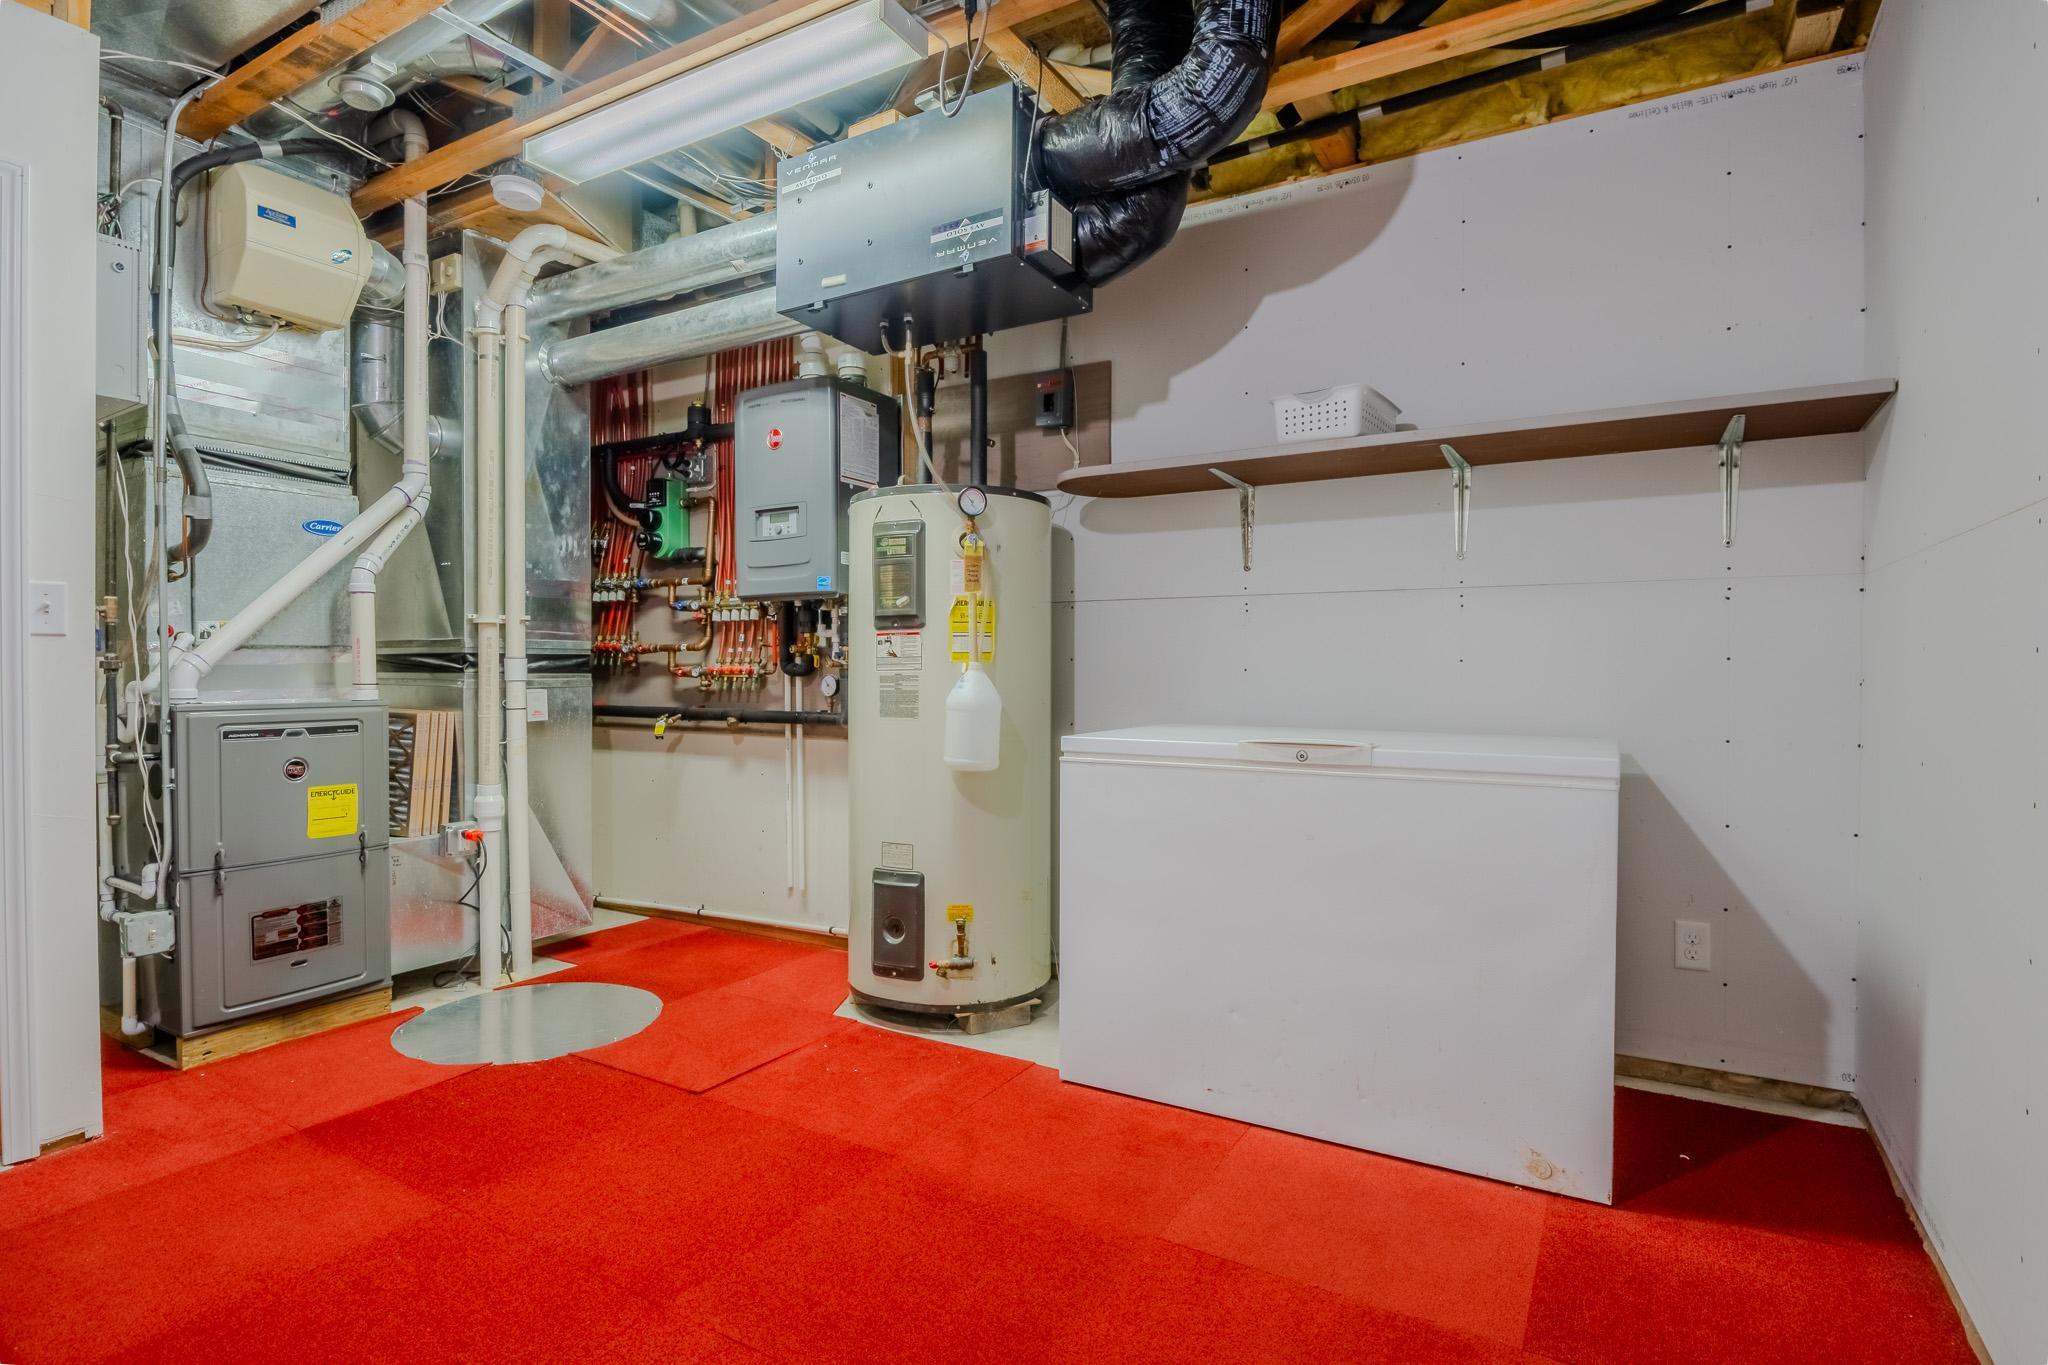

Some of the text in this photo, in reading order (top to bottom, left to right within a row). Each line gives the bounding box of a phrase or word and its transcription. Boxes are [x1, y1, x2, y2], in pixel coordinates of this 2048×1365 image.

[1213, 47, 1236, 80] DUCT
[786, 154, 838, 176] VENMAR
[946, 227, 968, 238] SOLO
[935, 237, 998, 258] VENMAR
[309, 522, 342, 532] Carrier
